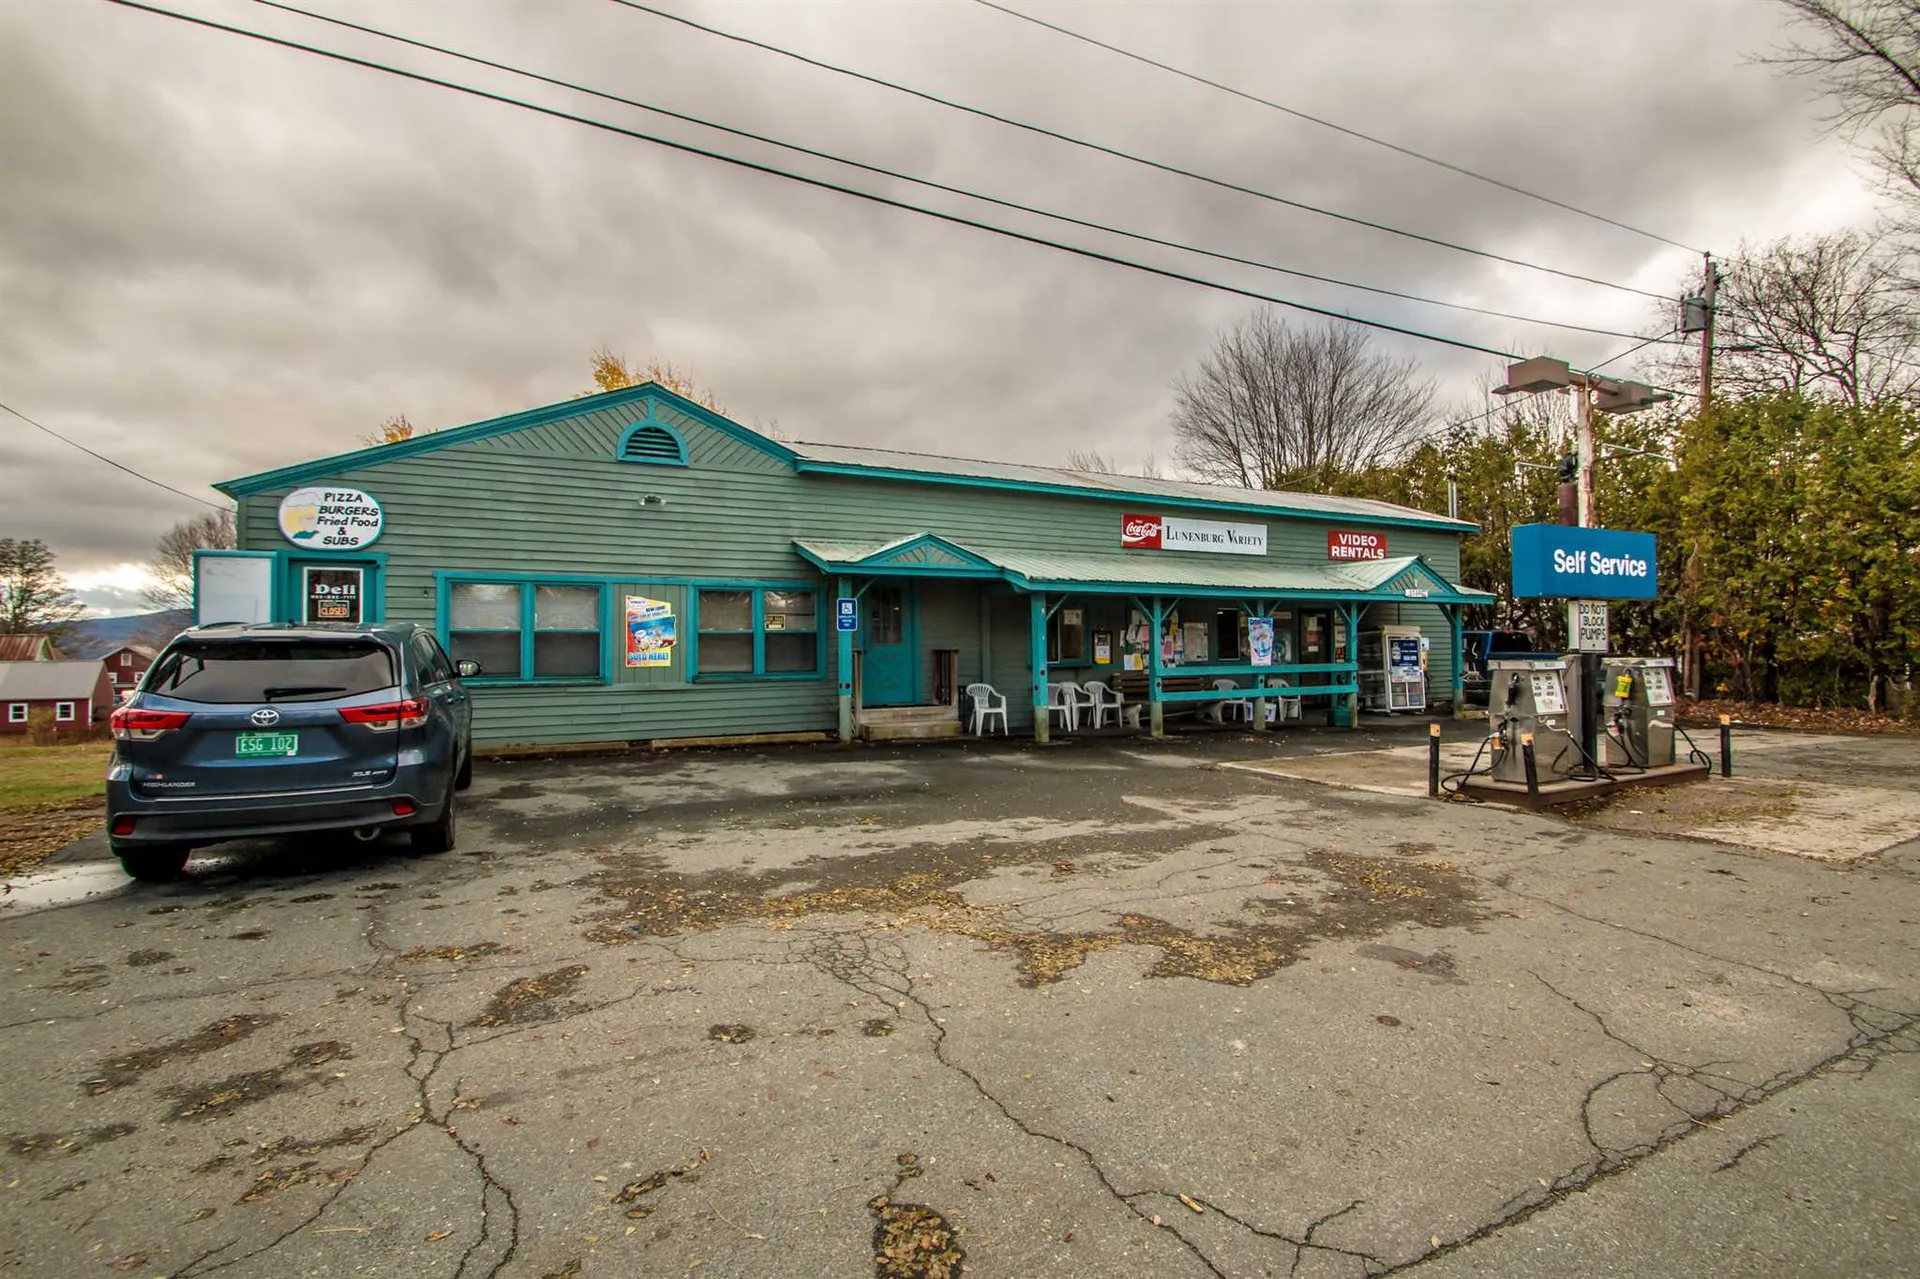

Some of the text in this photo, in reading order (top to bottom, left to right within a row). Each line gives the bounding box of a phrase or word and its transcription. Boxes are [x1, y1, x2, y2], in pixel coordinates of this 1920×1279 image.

[324, 492, 363, 503] PIZZA
[318, 505, 379, 517] BURGERS
[317, 515, 379, 527] Fried Food
[337, 526, 347, 536] &
[1126, 521, 1161, 538] Coca-Cola
[322, 535, 360, 546] SUBS
[1166, 525, 1264, 547] LUNENBURG VARIETY
[1338, 533, 1378, 547] VIDEO
[1331, 545, 1385, 559] RENTALS
[1553, 548, 1647, 577] Self Service
[314, 584, 356, 595] Deli
[321, 607, 348, 616] CLOSED
[1579, 603, 1590, 615] DO
[1583, 616, 1605, 627] BLOCK
[1581, 627, 1606, 640] PUMPS
[240, 736, 293, 752] ESG 102
